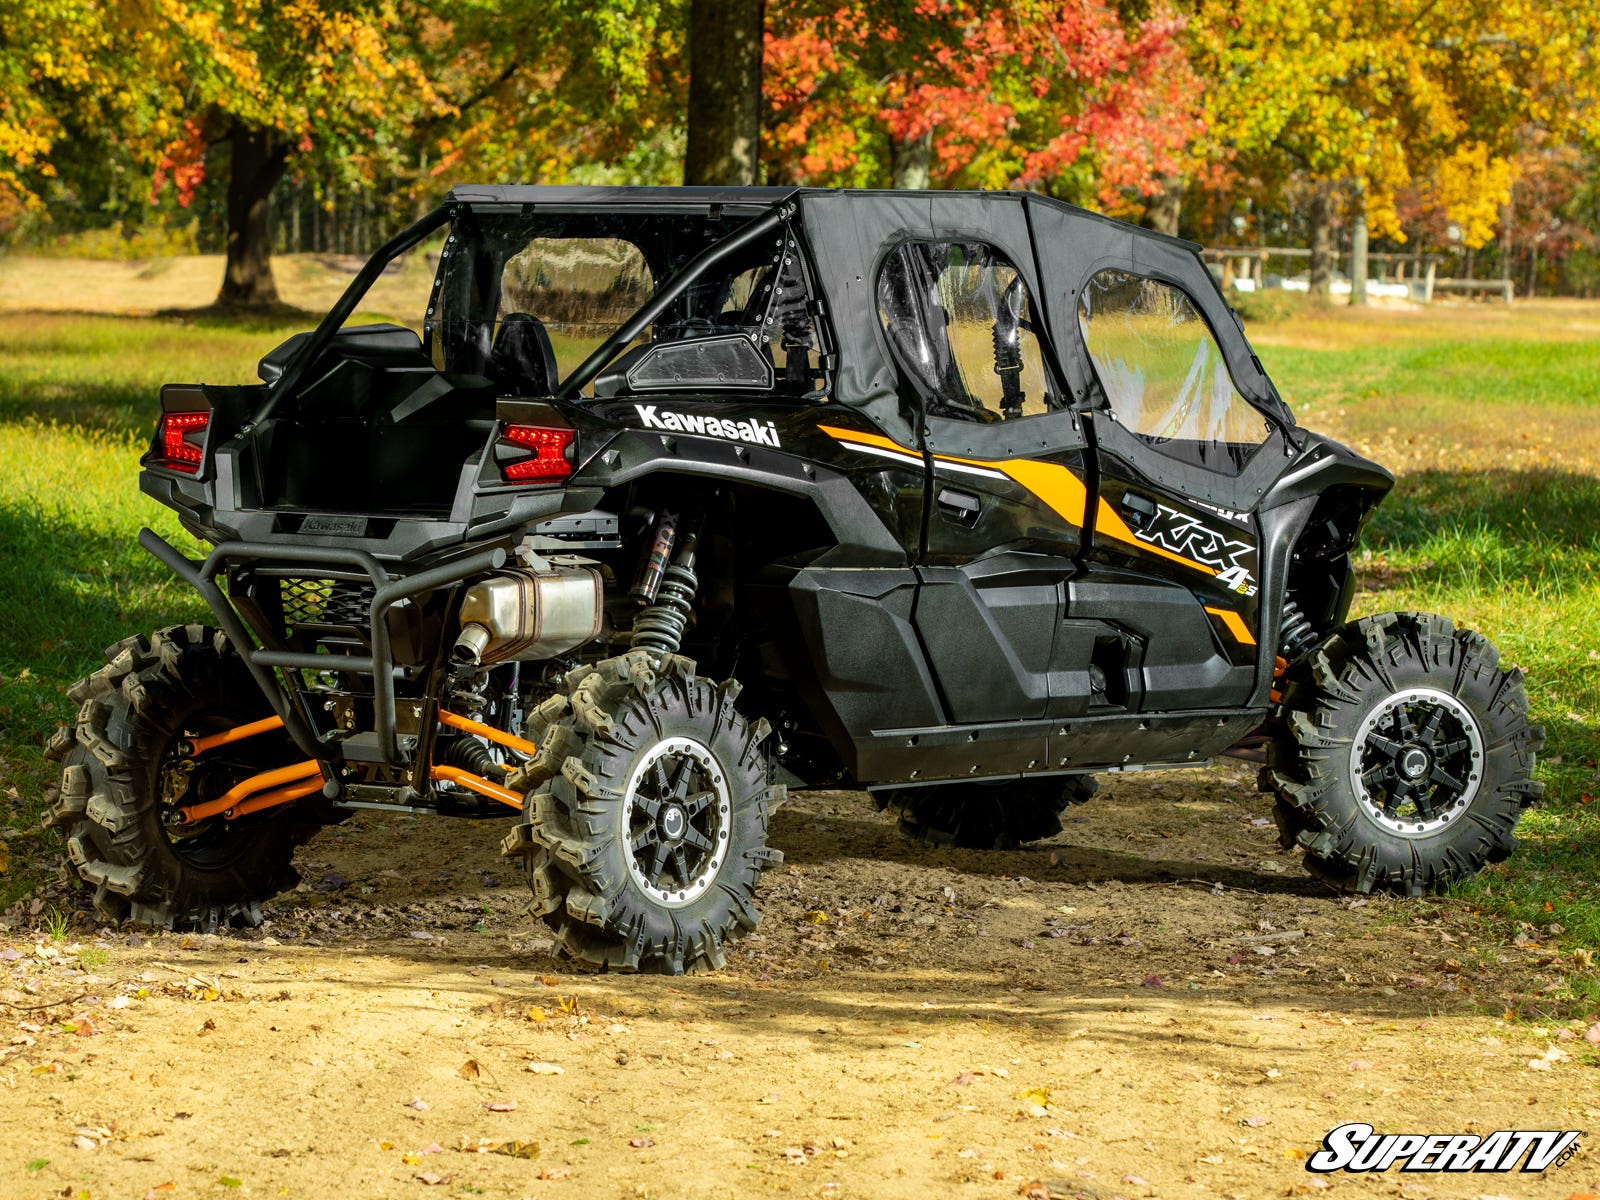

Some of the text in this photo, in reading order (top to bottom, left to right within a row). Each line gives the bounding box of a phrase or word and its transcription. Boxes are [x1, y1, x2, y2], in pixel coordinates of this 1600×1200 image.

[634, 404, 781, 448] Kawasaki
[303, 519, 364, 533] Kawasaki
[1134, 503, 1256, 581] KRX
